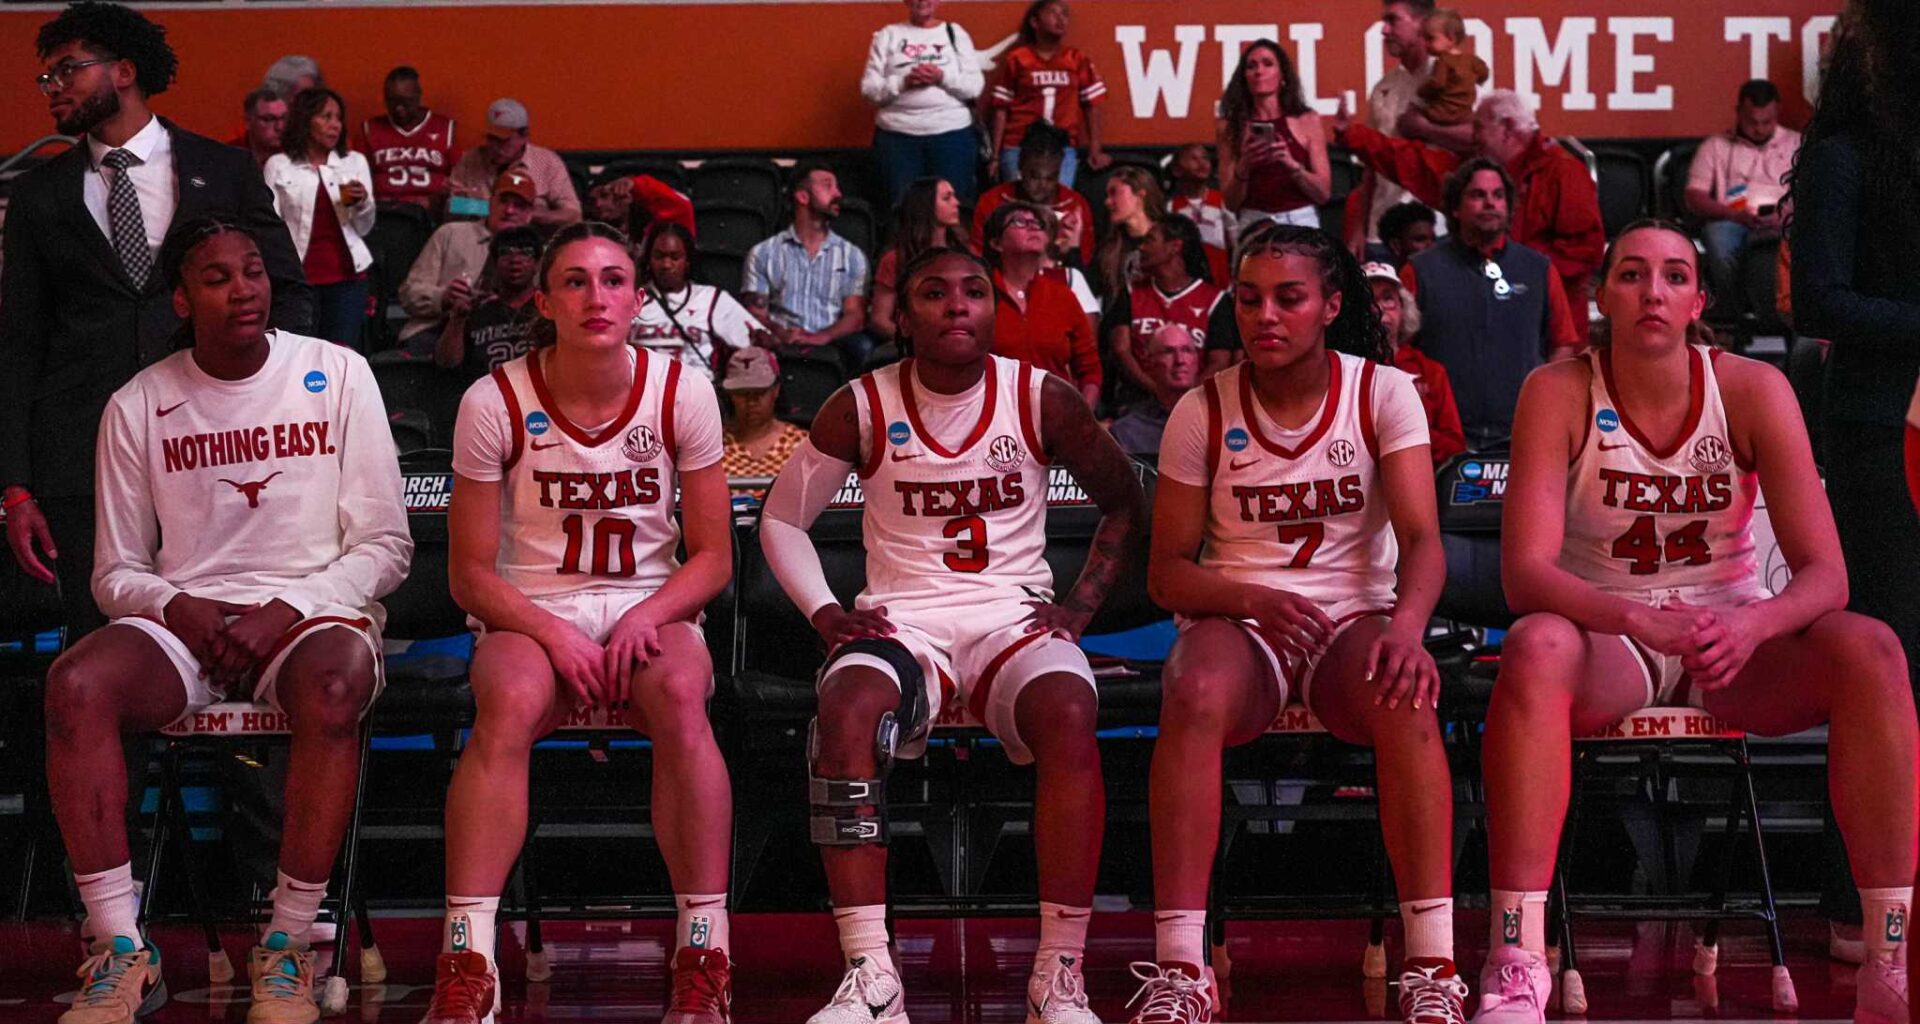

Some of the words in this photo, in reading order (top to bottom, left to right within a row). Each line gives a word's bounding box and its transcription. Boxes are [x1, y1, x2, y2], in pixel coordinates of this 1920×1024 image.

[1031, 70, 1070, 86] TEXAS
[1042, 87, 1057, 126] 1
[374, 147, 443, 166] TEXAS
[162, 426, 269, 473] NOTHING
[273, 421, 336, 459] EASY.
[628, 426, 655, 453] SEC
[990, 436, 1016, 462] SEC
[1328, 441, 1354, 466] SEC
[1695, 437, 1723, 464] SEC
[533, 468, 661, 509] TEXAS
[894, 472, 1025, 517] TEXAS
[1232, 474, 1364, 522] TEXAS
[1599, 468, 1732, 513] TEXAS
[556, 514, 637, 578] 10
[942, 514, 989, 573] 3
[1277, 522, 1325, 568] 7
[1611, 515, 1712, 575] 44
[1631, 716, 1676, 737] EM'
